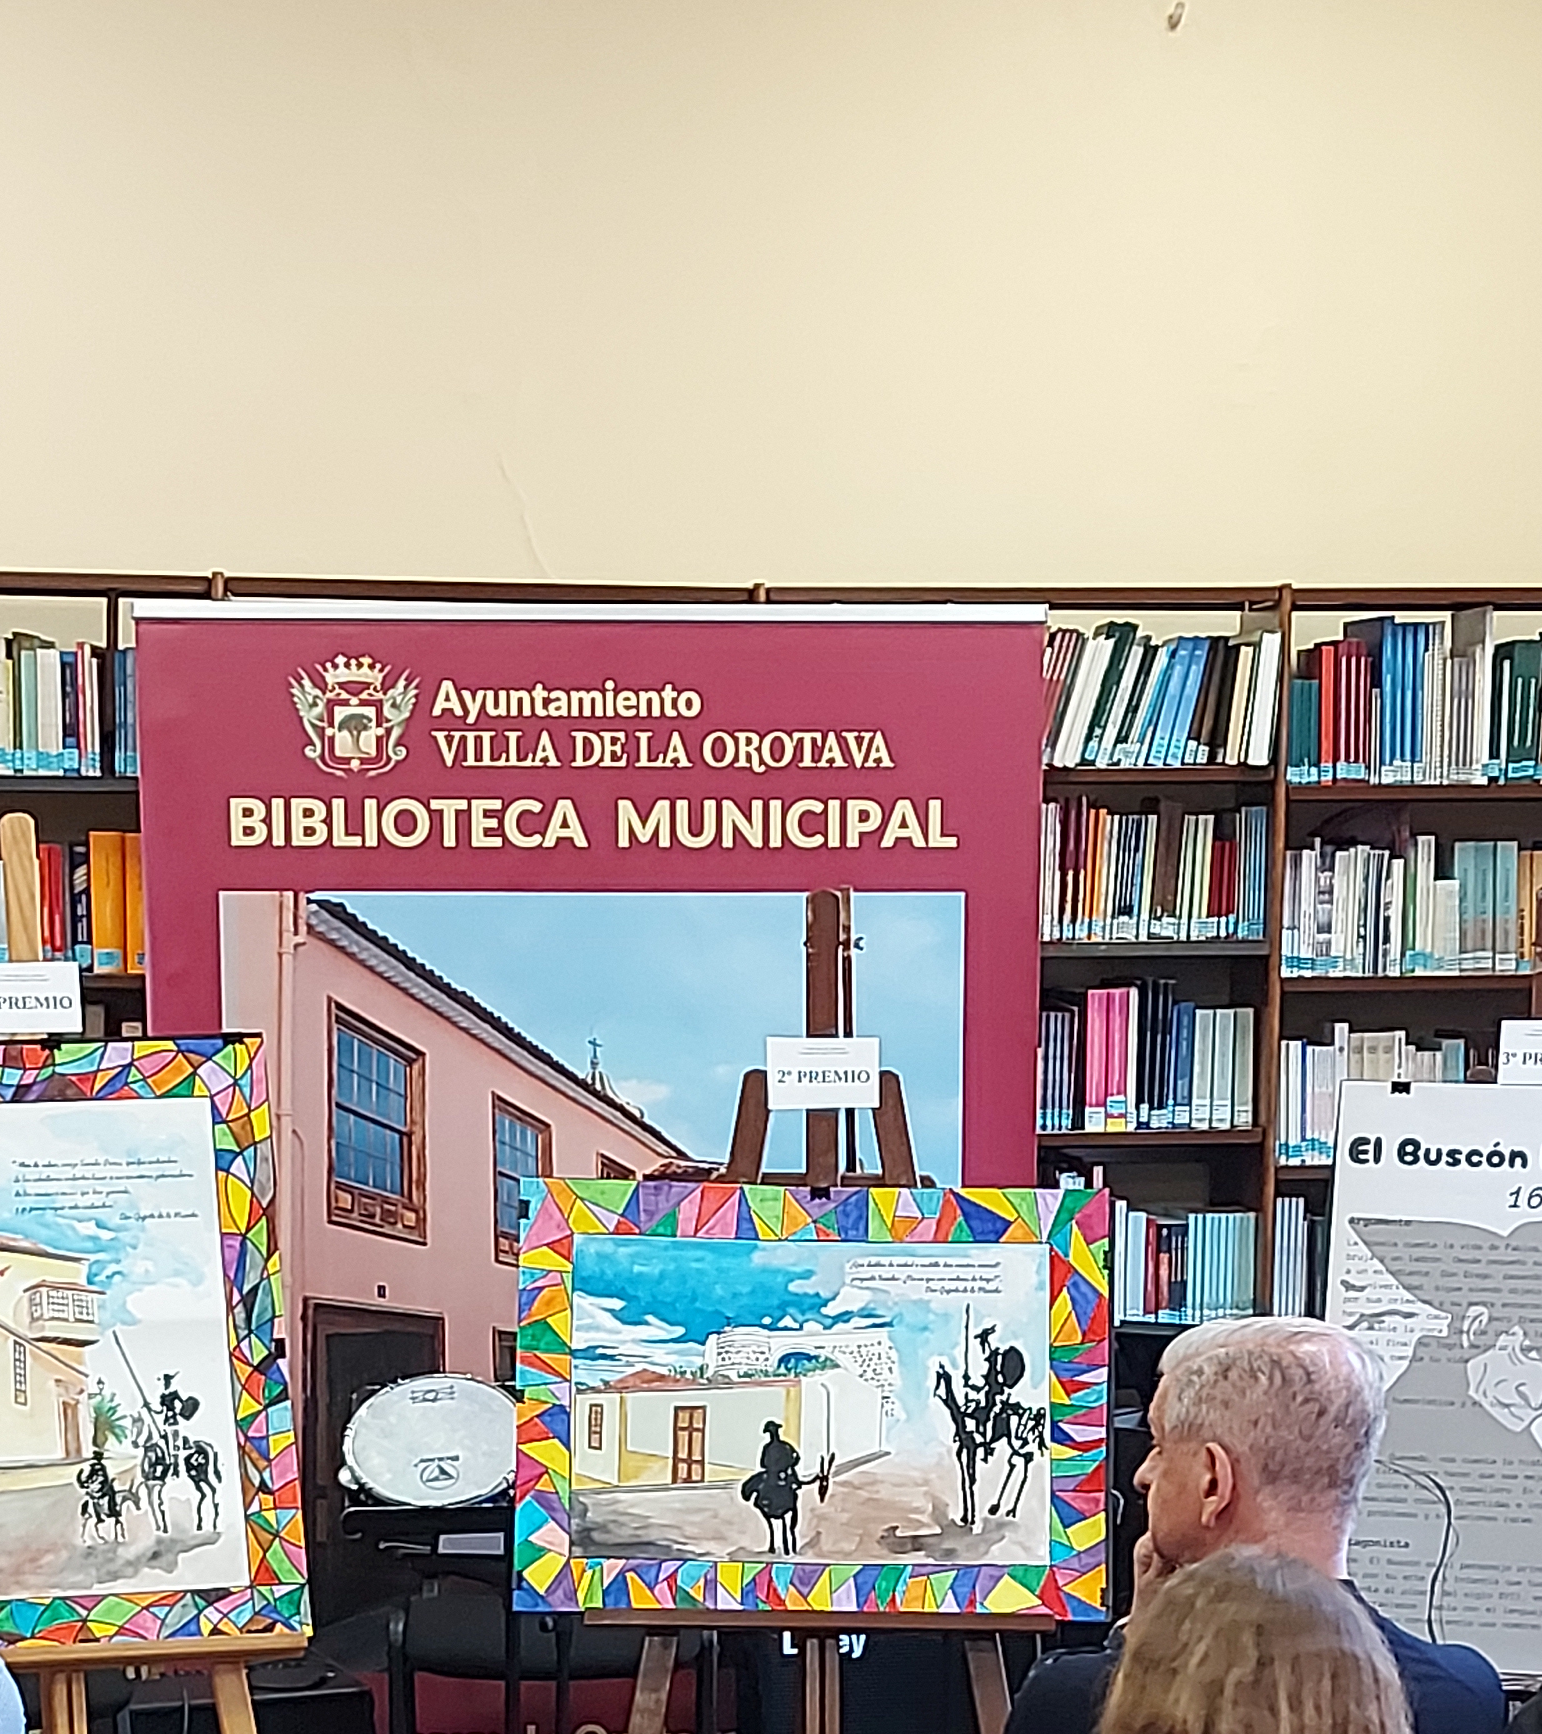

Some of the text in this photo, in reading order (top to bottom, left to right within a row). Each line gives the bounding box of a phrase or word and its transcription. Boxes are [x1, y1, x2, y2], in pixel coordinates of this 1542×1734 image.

[431, 679, 702, 724] Ayuntamiento
[431, 729, 895, 773] VILLA DE LA OROTAVA
[229, 797, 957, 849] BIBLIOTECA MUNICIPAL
[797, 1069, 870, 1084] PREMIO
[1348, 1137, 1382, 1165] El
[1396, 1137, 1528, 1170] Buscón
